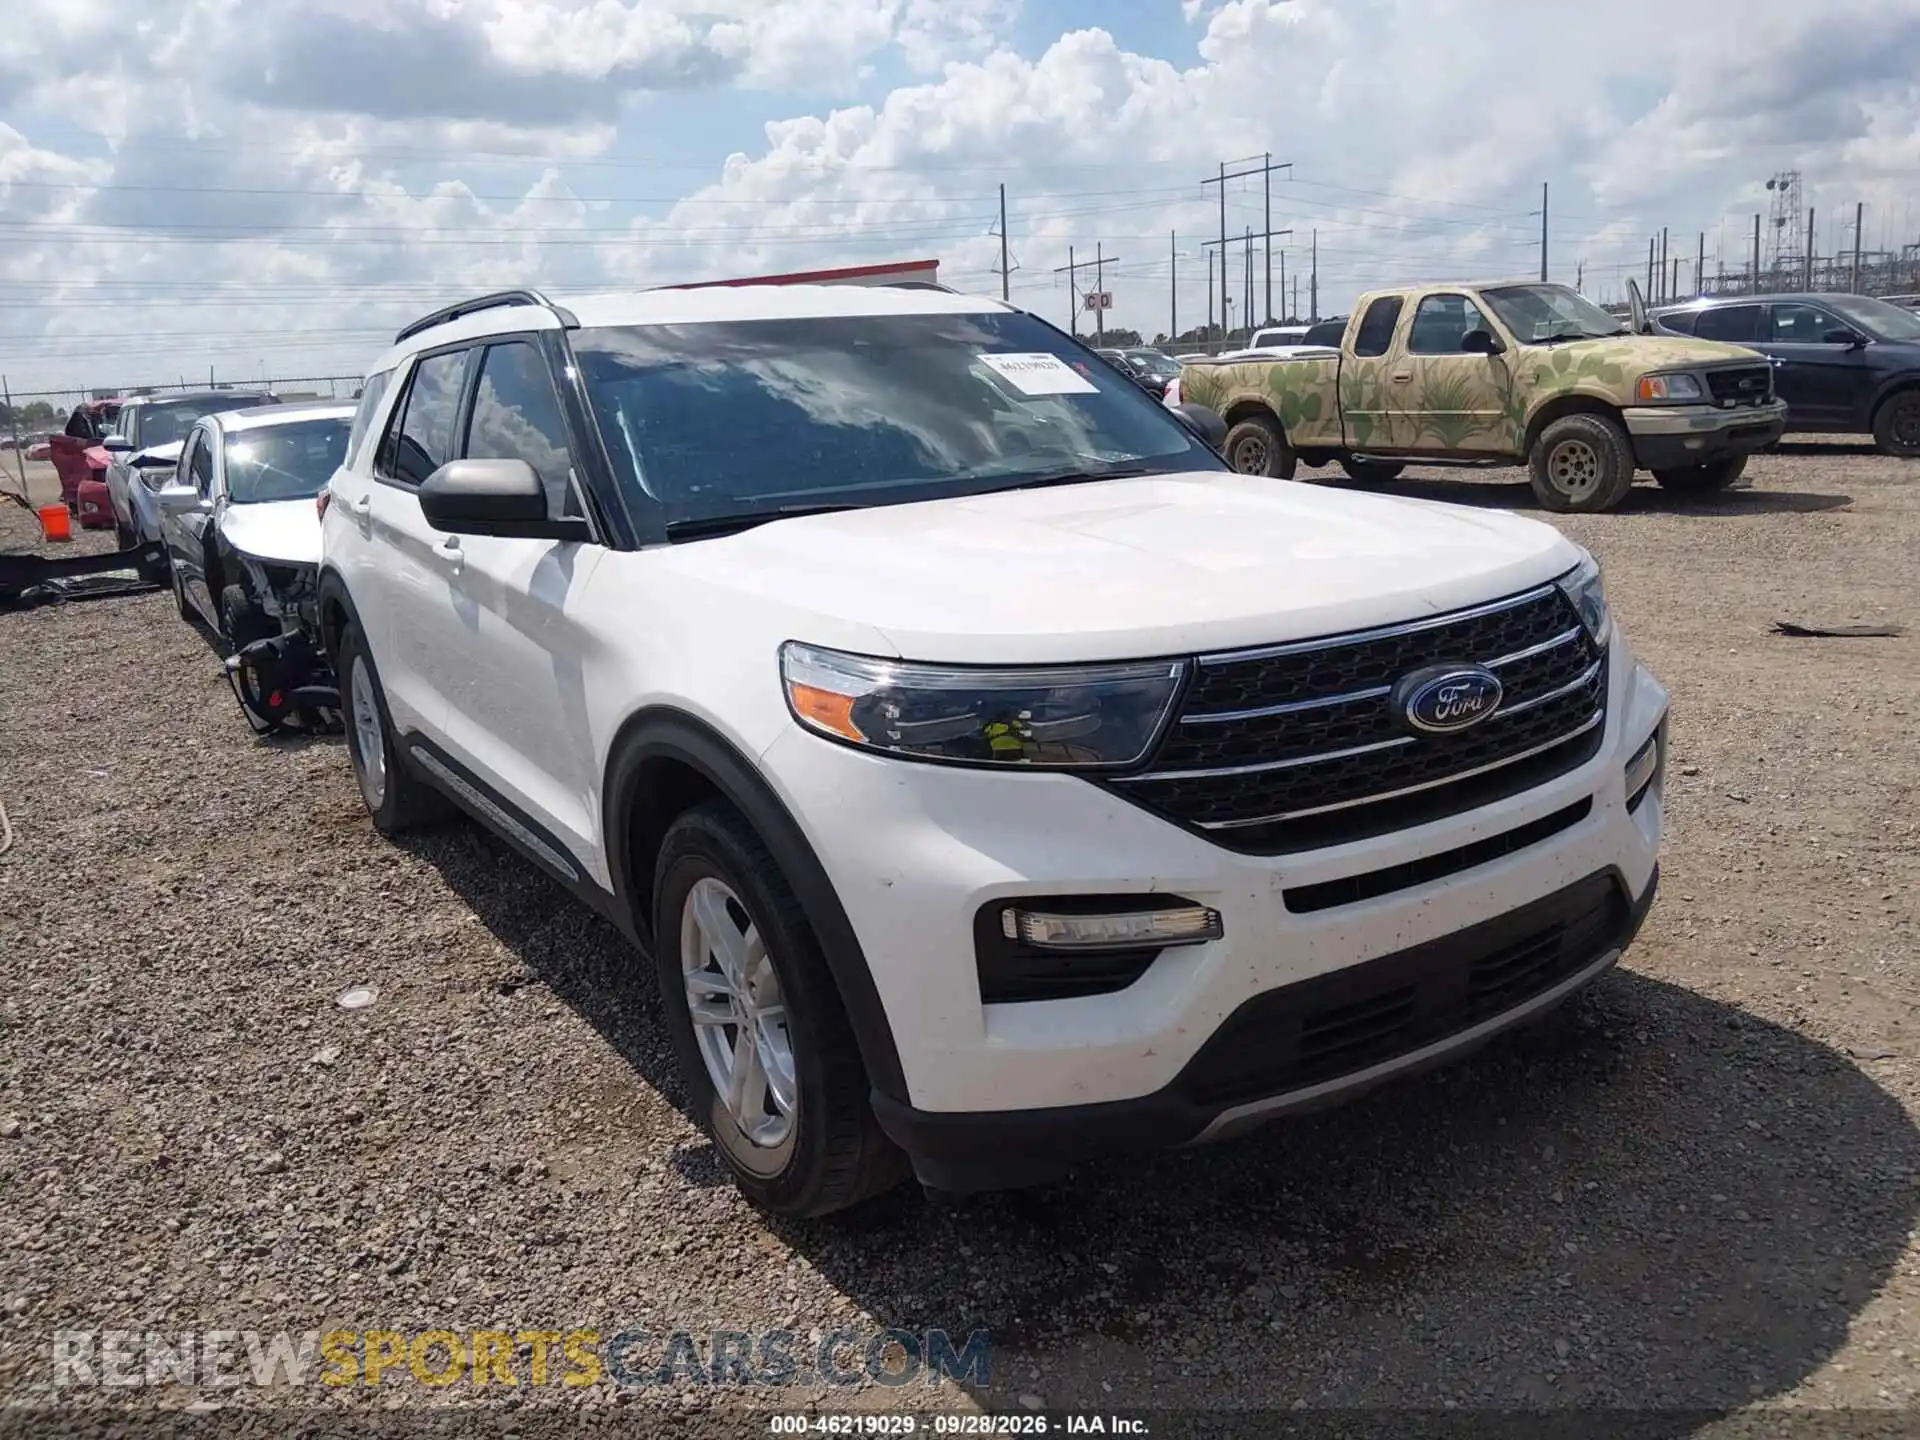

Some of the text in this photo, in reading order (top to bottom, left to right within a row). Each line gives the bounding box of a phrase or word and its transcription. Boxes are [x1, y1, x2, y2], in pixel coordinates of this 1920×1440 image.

[1088, 294, 1109, 308] C D
[1435, 682, 1484, 719] Ford
